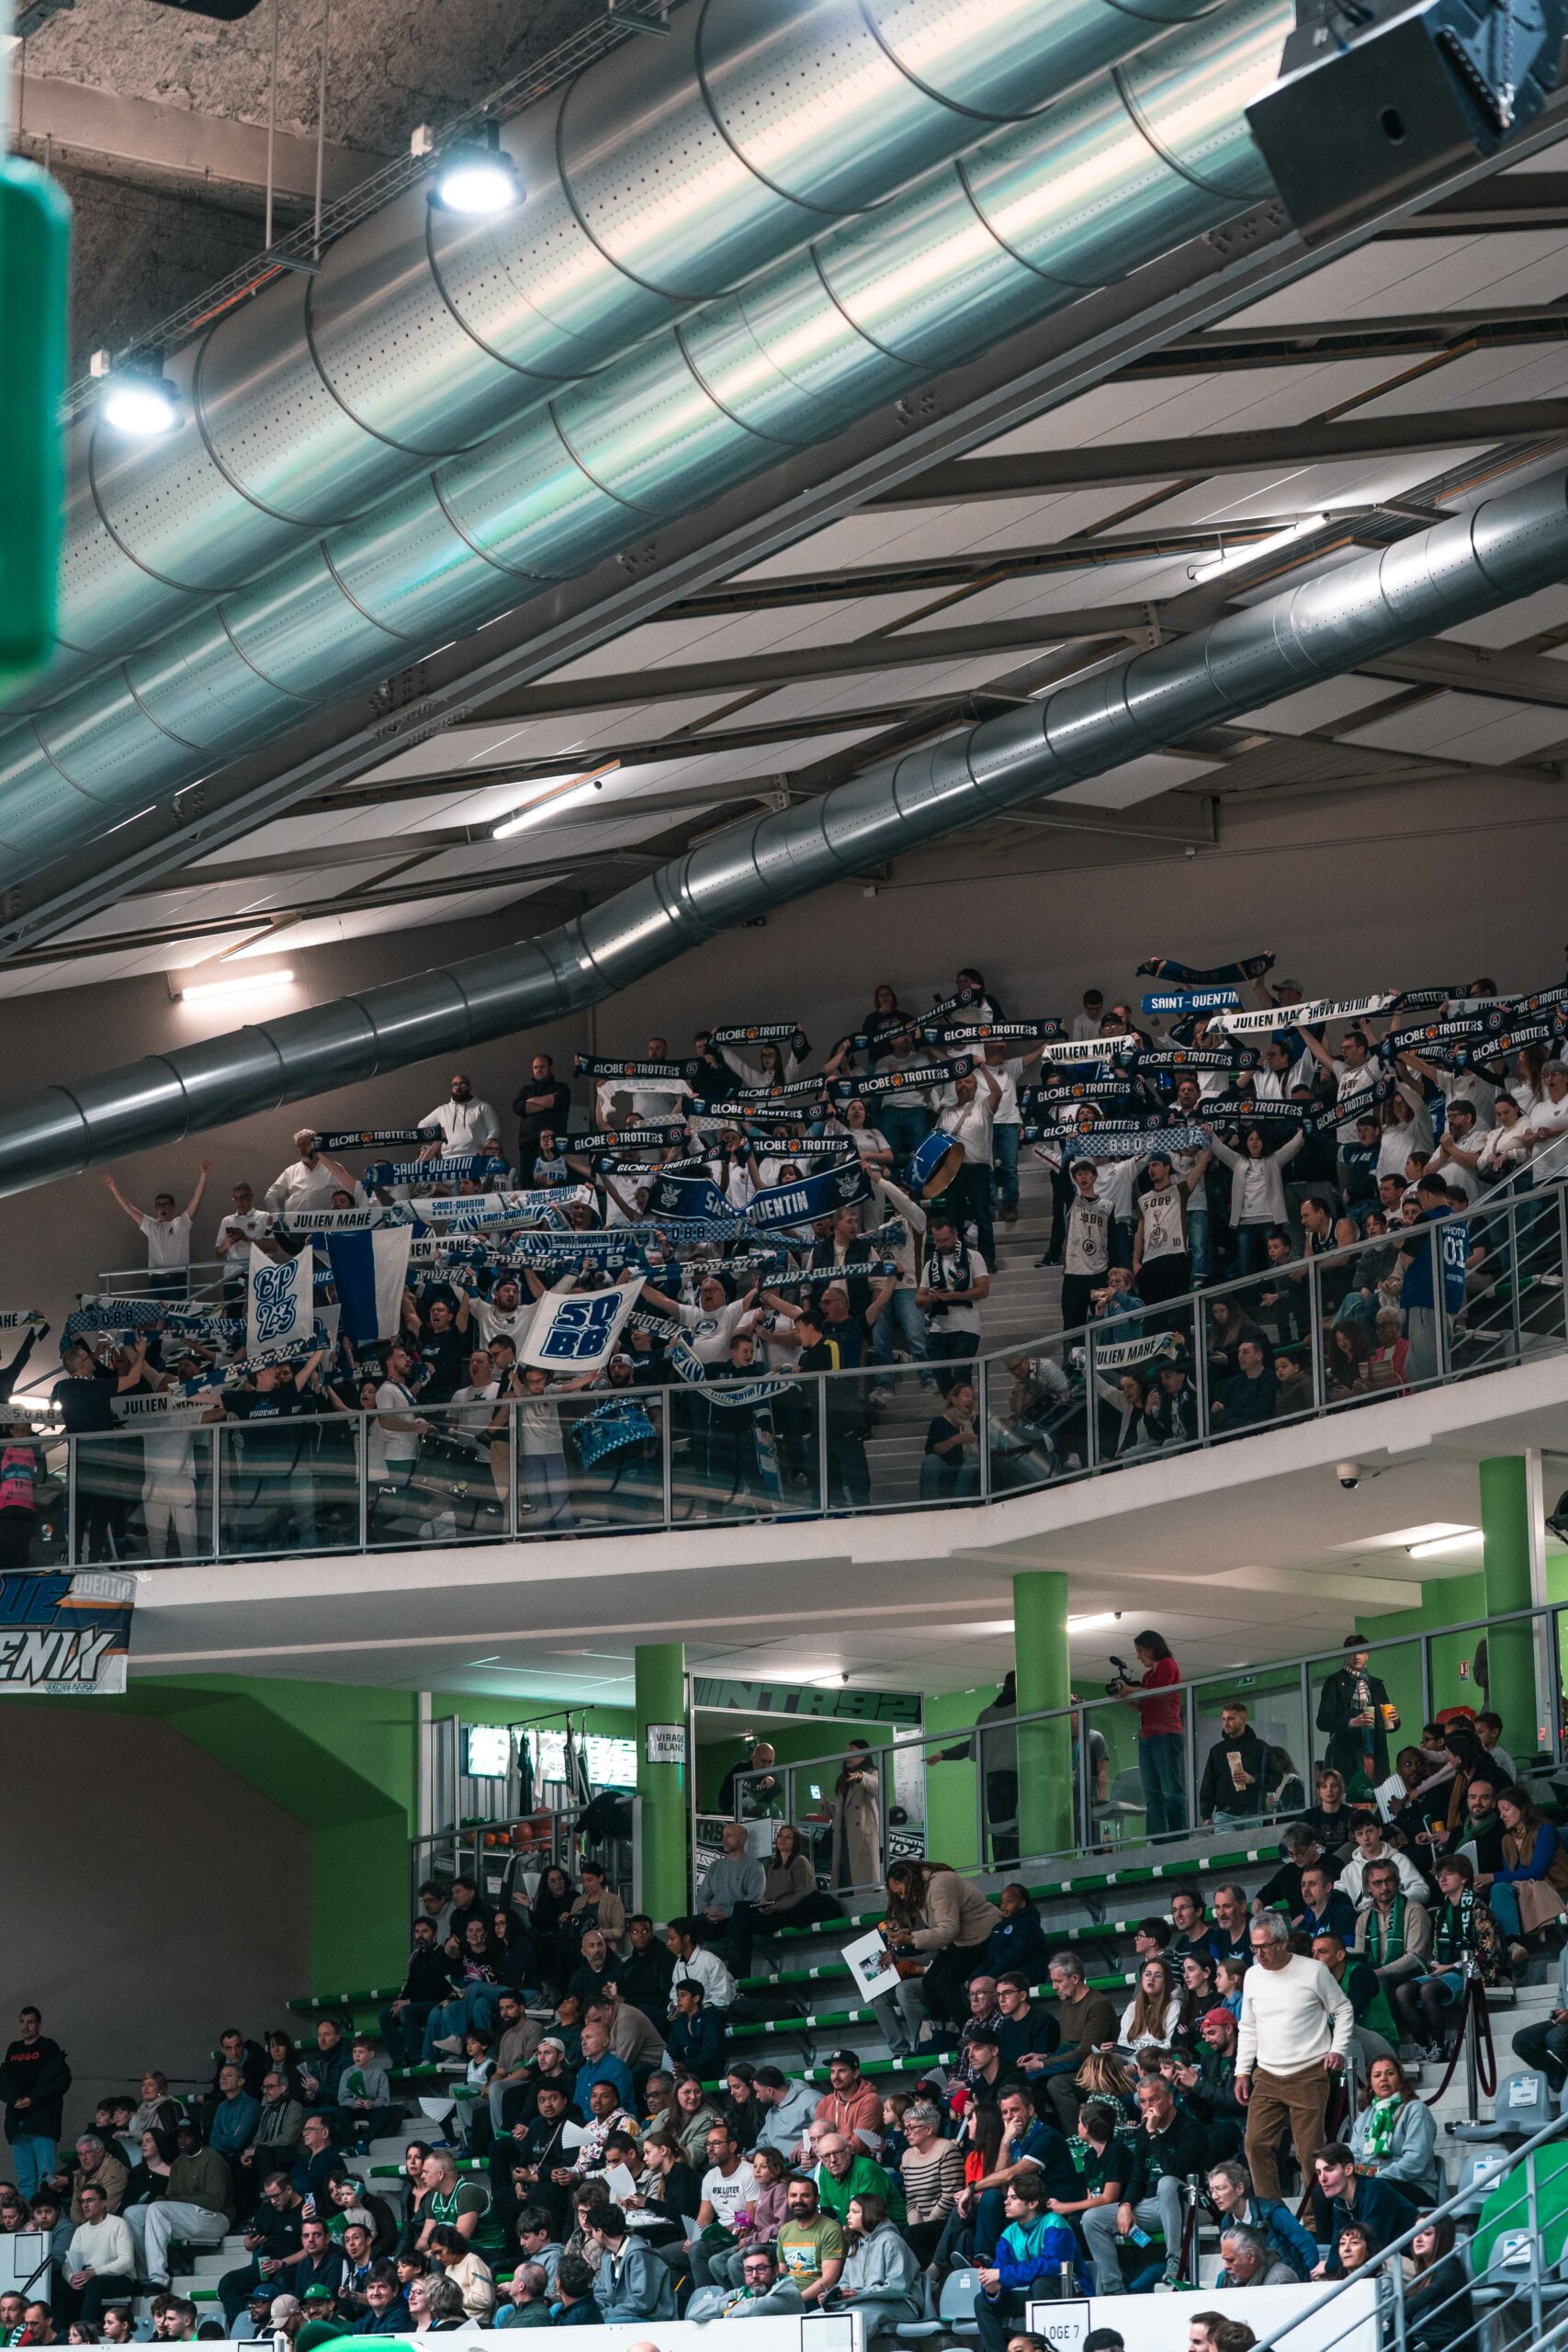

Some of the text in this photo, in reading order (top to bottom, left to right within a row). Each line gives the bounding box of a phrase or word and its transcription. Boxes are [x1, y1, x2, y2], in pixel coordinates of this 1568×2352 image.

[1151, 989, 1239, 1009] SAINT-QUENTIN
[1233, 1014, 1273, 1029] JULIEN
[716, 1029, 746, 1041] GLOBE
[874, 1026, 904, 1043] GLOBE
[944, 1028, 977, 1041] GLOBE
[1394, 1028, 1426, 1046] GLOBE
[1050, 1037, 1126, 1060] JULIEN MAHÉ
[1472, 1040, 1500, 1061] GLOBE
[1138, 1053, 1172, 1066] GLOBE
[593, 1063, 624, 1074] GLOBE
[858, 1077, 890, 1093] GLOBE
[739, 1088, 770, 1098] GLOBE
[1037, 1087, 1070, 1102] GLOBE
[711, 1103, 743, 1114] GLOBE
[1202, 1102, 1239, 1114] GLOBE
[1316, 1110, 1337, 1131] GLOBE
[1043, 1125, 1077, 1137] GLOBE
[329, 1134, 361, 1148] GLOBE
[575, 1135, 606, 1150] GLOBE
[753, 1140, 786, 1151] GLOBE
[393, 1157, 473, 1176] SAINT-QUENTIN
[616, 1163, 650, 1172] GLOBE
[432, 1198, 485, 1210] SAINT-QUENTIN
[746, 1191, 809, 1225] QUENTIN
[294, 1212, 371, 1227] JULIEN MAHÉ
[482, 1208, 533, 1222] SAINT-QUENTIN
[1442, 1225, 1465, 1238] PHOTO
[1443, 1236, 1466, 1268] 01
[539, 1325, 612, 1359] BB
[1127, 1338, 1156, 1361] MAHÉ
[122, 1397, 167, 1415] JULIEN
[249, 1408, 279, 1418] PHOENIX
[48, 1683, 97, 1691] SINCE 2023
[656, 1733, 684, 1742] VIRAGE
[658, 1743, 684, 1752] BLANC
[10, 2052, 40, 2062] HUGO
[1074, 2324, 1080, 2338] 7
